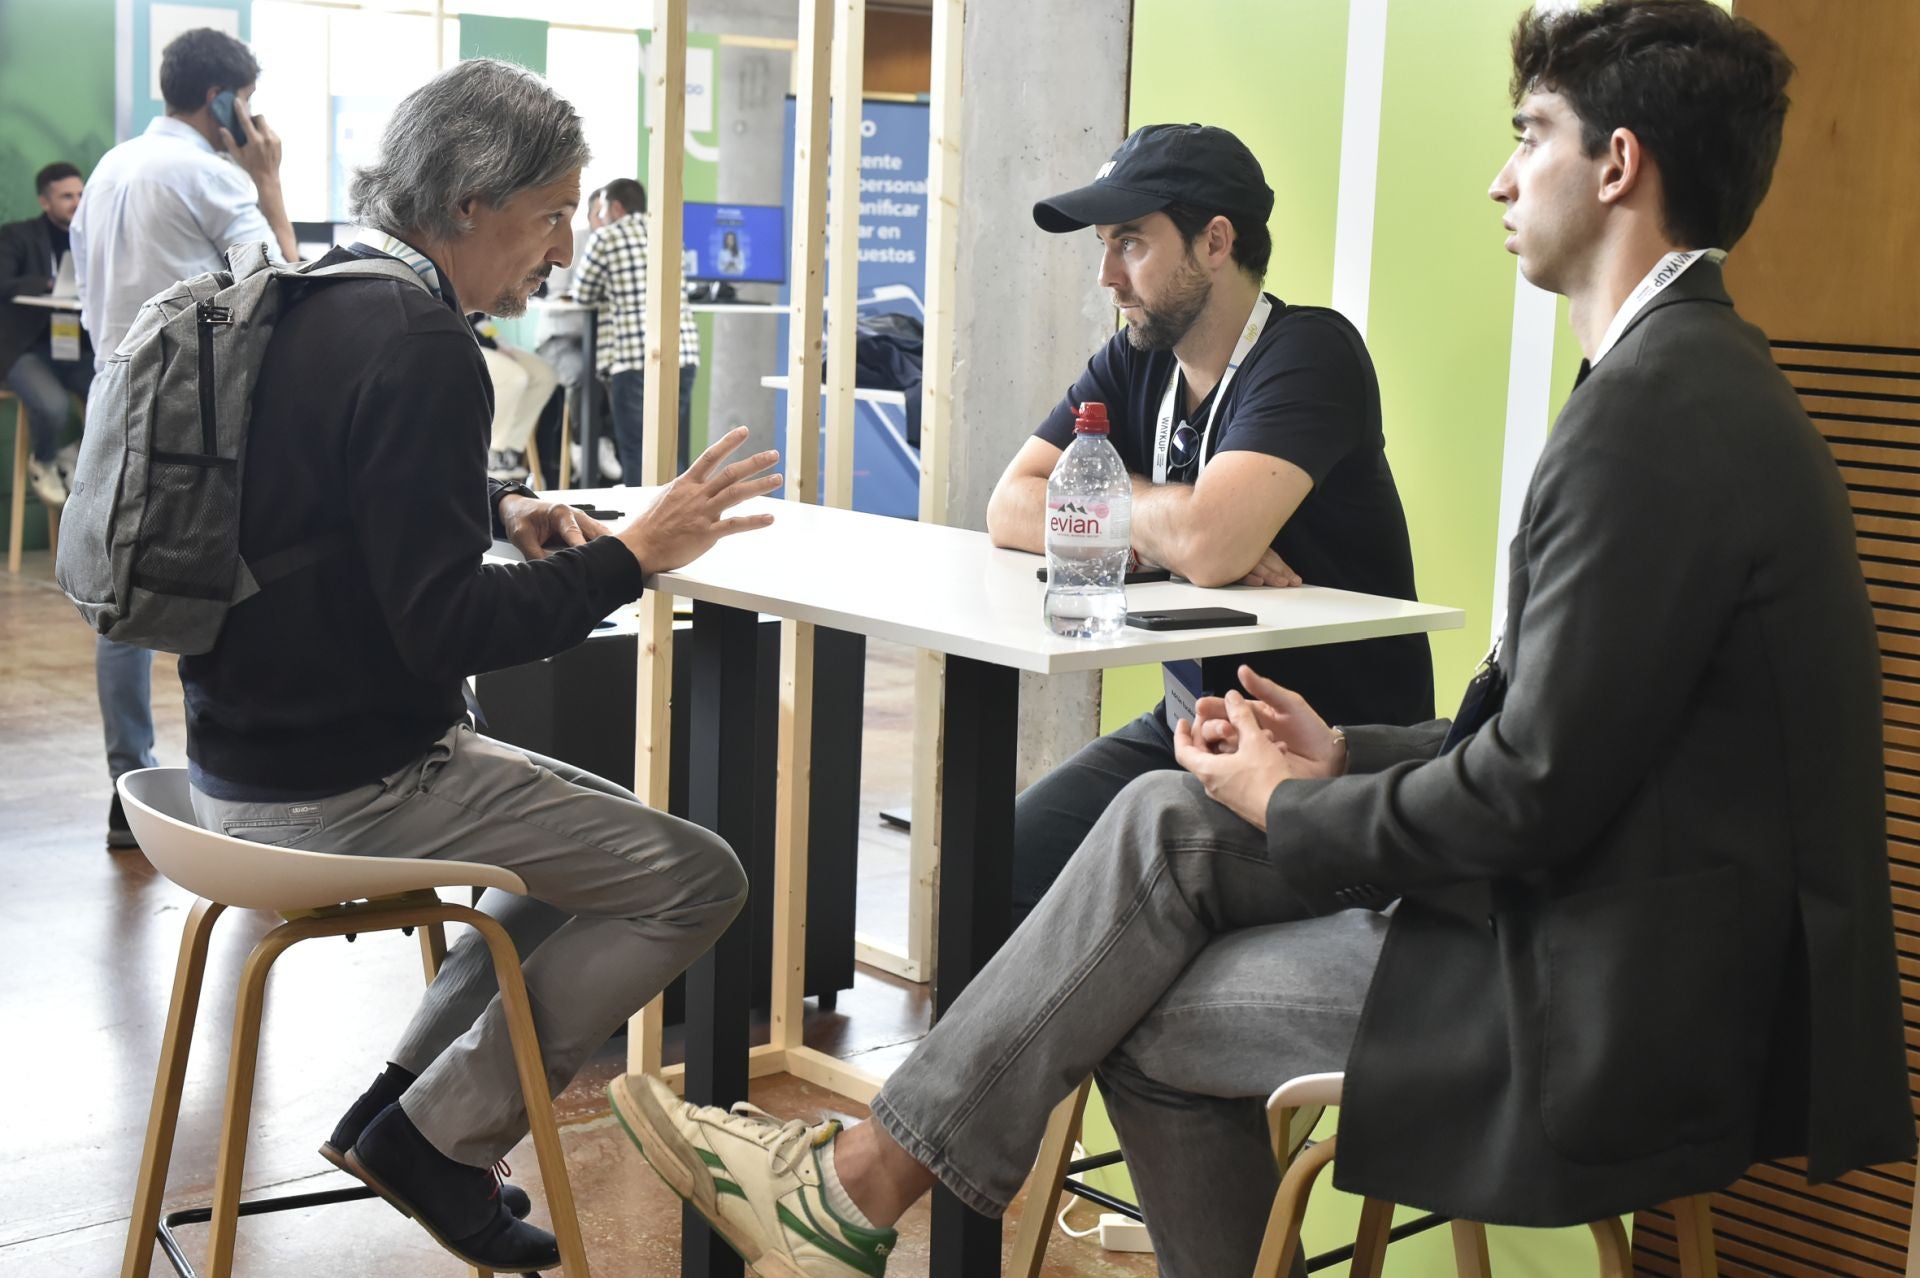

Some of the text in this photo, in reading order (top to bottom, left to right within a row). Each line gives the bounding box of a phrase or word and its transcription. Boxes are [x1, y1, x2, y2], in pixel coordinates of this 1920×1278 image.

[861, 154, 902, 170] ente
[859, 199, 920, 217] anificar
[858, 225, 901, 240] ar en
[857, 248, 916, 264] uestos
[1654, 253, 1695, 288] WAYKUP
[1158, 416, 1170, 452] WAYKUP
[1050, 515, 1099, 534] evian
